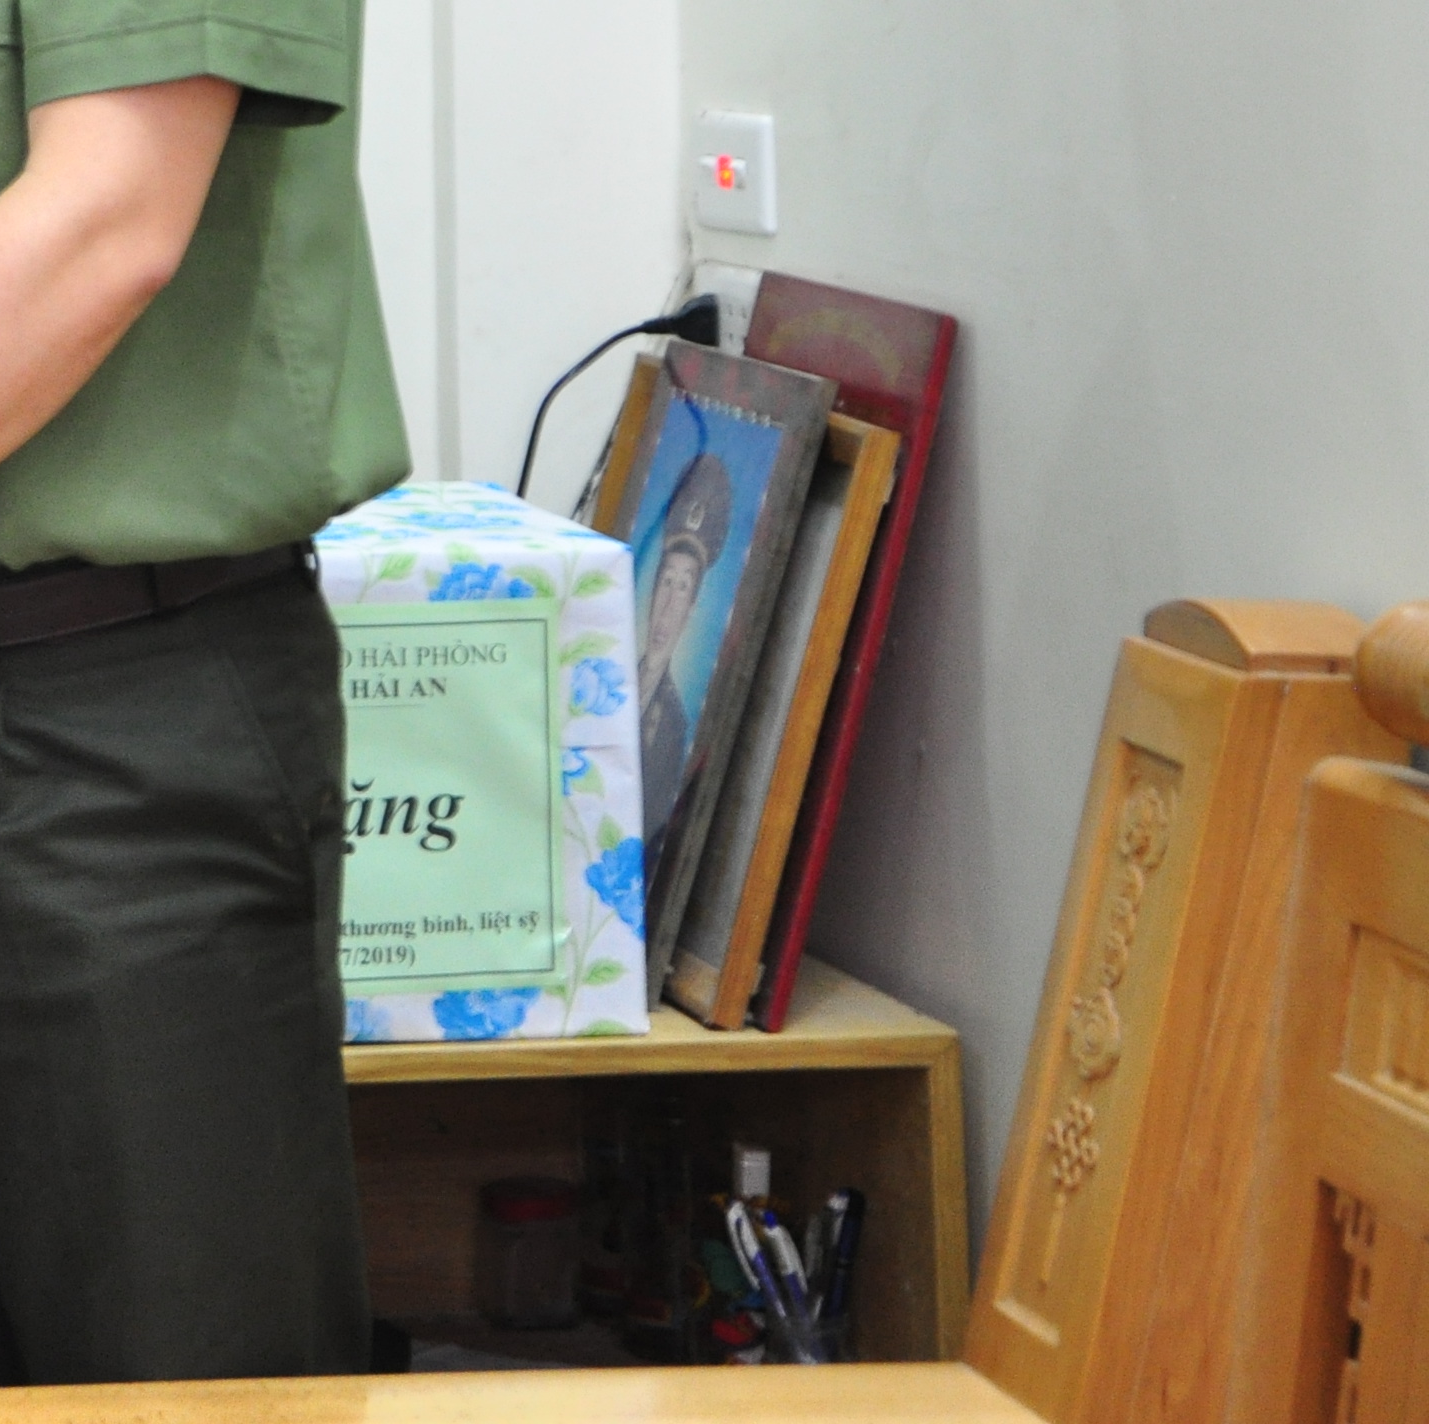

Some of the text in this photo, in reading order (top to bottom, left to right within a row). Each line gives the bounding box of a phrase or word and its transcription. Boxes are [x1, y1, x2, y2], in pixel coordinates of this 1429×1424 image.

[360, 642, 408, 668] HẢI
[415, 639, 508, 668] PHÒNG
[351, 673, 447, 698] HẢI AN
[342, 777, 466, 854] ặng
